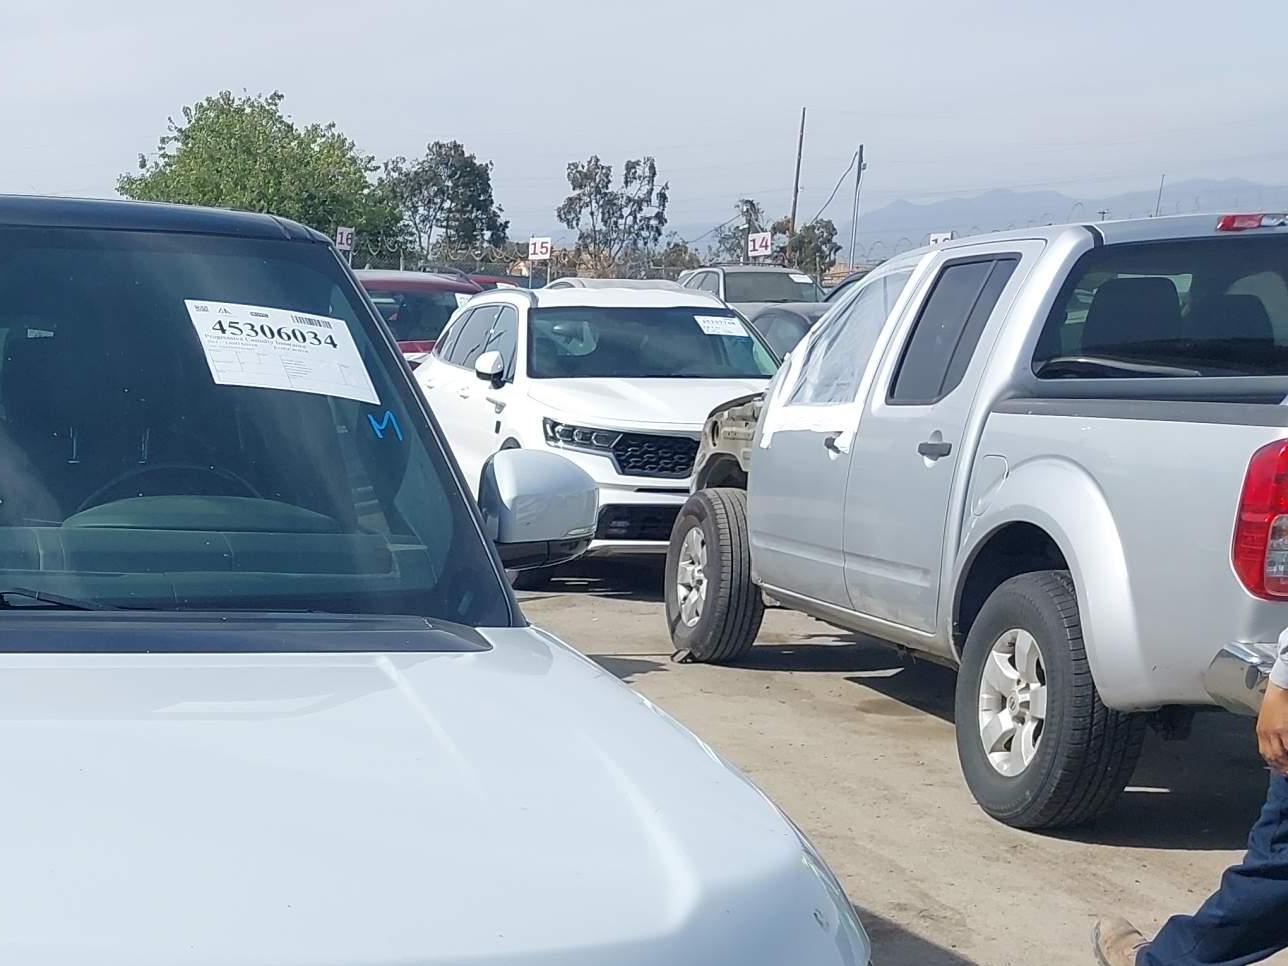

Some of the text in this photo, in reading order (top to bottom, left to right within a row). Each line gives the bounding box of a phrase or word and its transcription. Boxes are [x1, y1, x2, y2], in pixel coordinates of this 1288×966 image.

[338, 231, 353, 246] 16
[750, 236, 769, 252] 14
[530, 241, 549, 256] 15
[211, 318, 338, 349] 45306034
